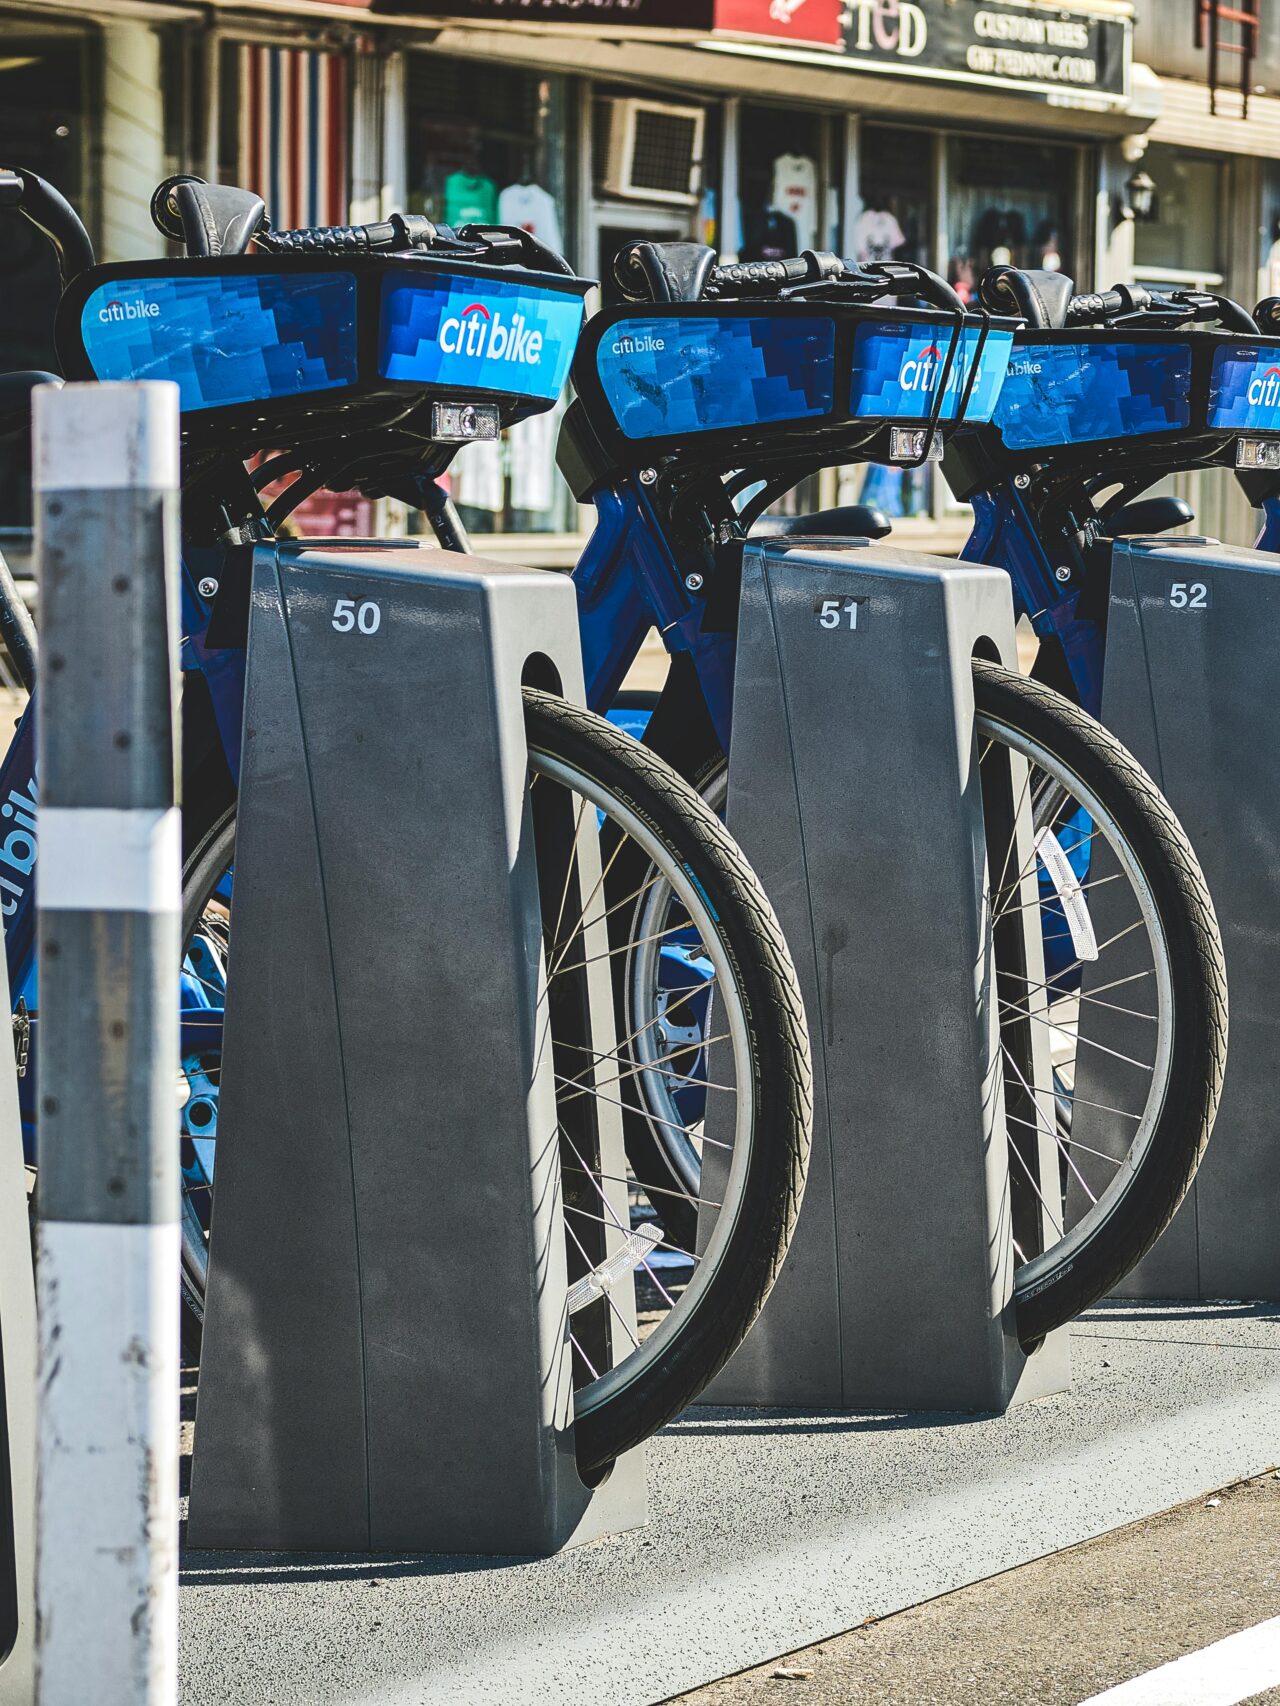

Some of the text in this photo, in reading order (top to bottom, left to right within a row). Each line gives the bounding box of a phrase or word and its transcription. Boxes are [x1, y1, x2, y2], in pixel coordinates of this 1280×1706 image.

[1169, 583, 1208, 609] 52
[331, 600, 381, 635] 50
[819, 601, 858, 630] 51
